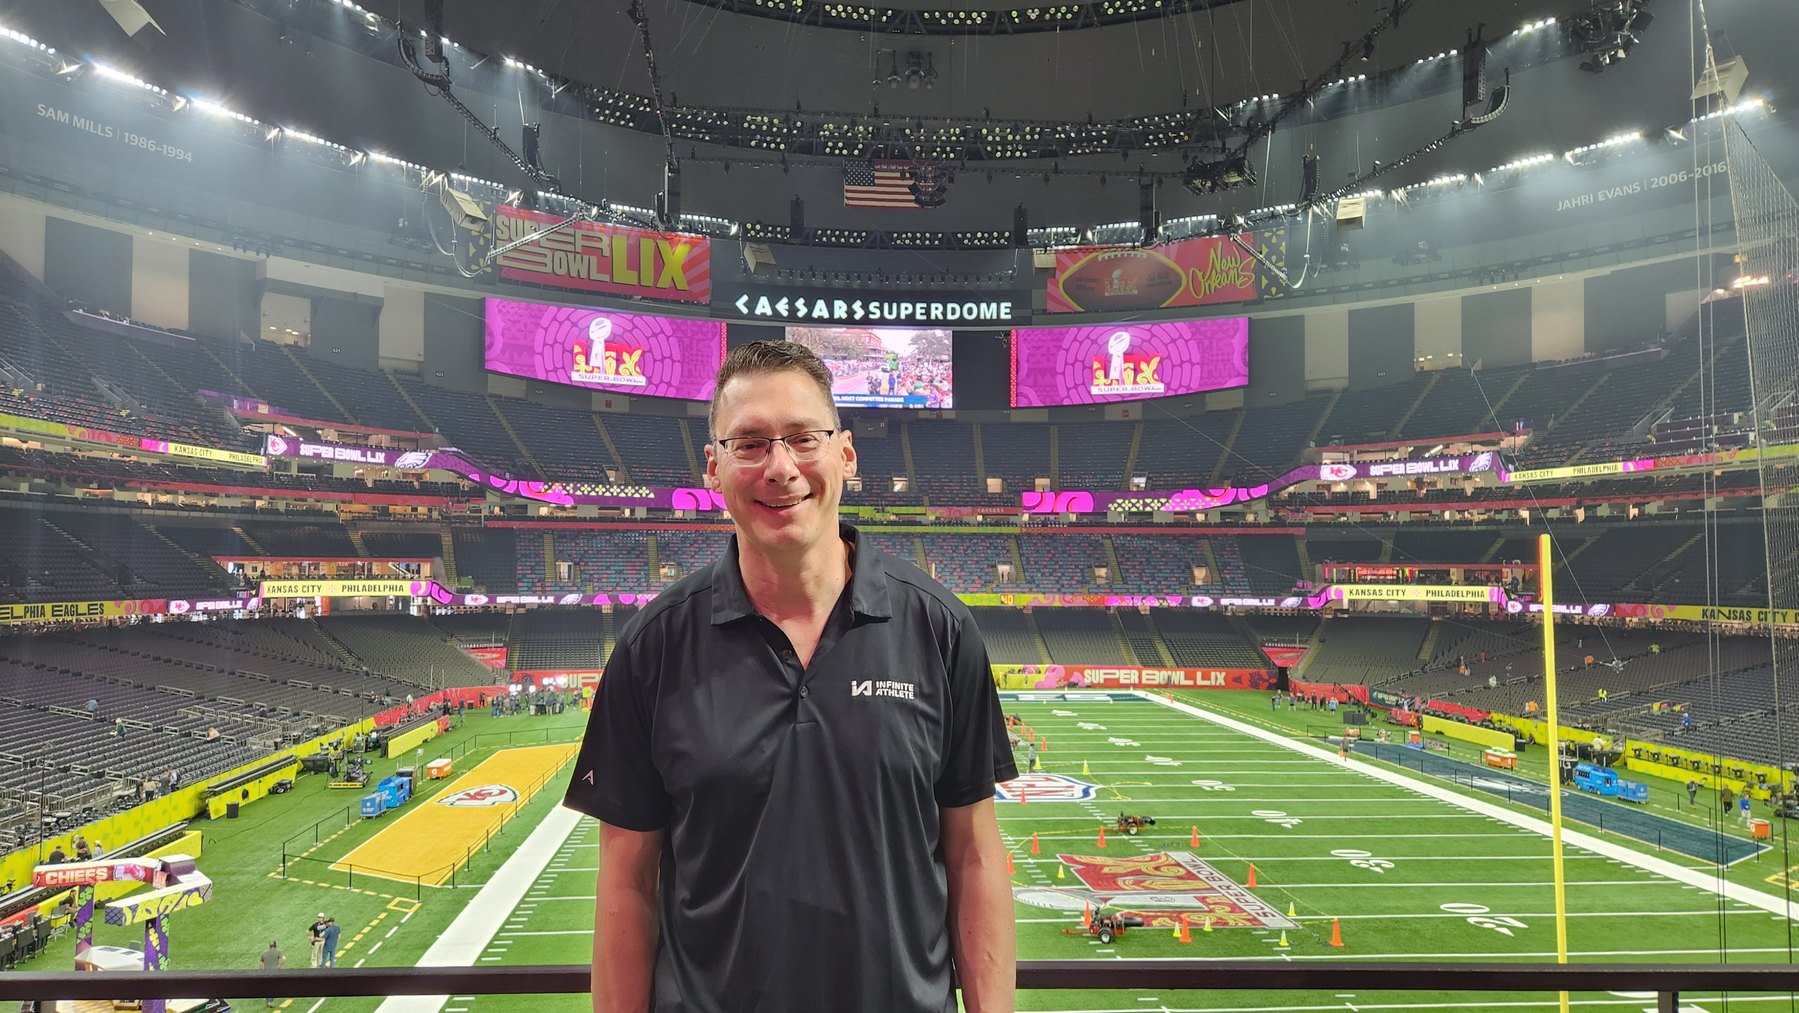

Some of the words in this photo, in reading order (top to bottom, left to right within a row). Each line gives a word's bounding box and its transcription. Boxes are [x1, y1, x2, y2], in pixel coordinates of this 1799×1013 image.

[36, 103, 69, 124] SAM
[72, 115, 113, 138] MILLS
[123, 131, 193, 163] 1986-1994
[1557, 192, 1594, 212] JAHRI
[1598, 182, 1641, 201] EVANS
[1651, 161, 1727, 189] 2006-2016
[496, 215, 610, 257] SUPER
[496, 240, 610, 282] BOWL
[612, 234, 692, 291] LIX
[1209, 240, 1241, 272] New
[735, 293, 866, 320] CAESARS
[868, 300, 1012, 320] SUPERDOME
[174, 445, 198, 456] KANSAS
[199, 448, 212, 457] CITY
[229, 453, 263, 464] PHILADELPHIA
[300, 444, 333, 458] SUPER
[335, 448, 366, 461] BOWL
[367, 451, 385, 463] LIX
[1370, 464, 1405, 475] SUPER
[1406, 461, 1439, 473] BOWL
[1440, 459, 1459, 471] LIX
[1573, 464, 1618, 474] PHILADELPHIA
[267, 585, 299, 593] KANSAS
[302, 585, 321, 593] CITY
[342, 584, 404, 592] PHILADELPHIA
[1426, 590, 1485, 598] PHILADELPHIA
[52, 603, 104, 617] EAGLES
[1702, 608, 1752, 621] KANSAS
[1758, 610, 1788, 623] CITY
[875, 680, 914, 692] INFINITE
[1083, 669, 1139, 684] SUPER
[1141, 671, 1194, 686] BOWL
[1196, 671, 1226, 686] LIX
[875, 688, 914, 700] ATHLETE
[1330, 849, 1395, 871] 30
[45, 867, 109, 885] CHIEFS
[1218, 884, 1276, 918] SUPER
[1440, 902, 1529, 931] 20
